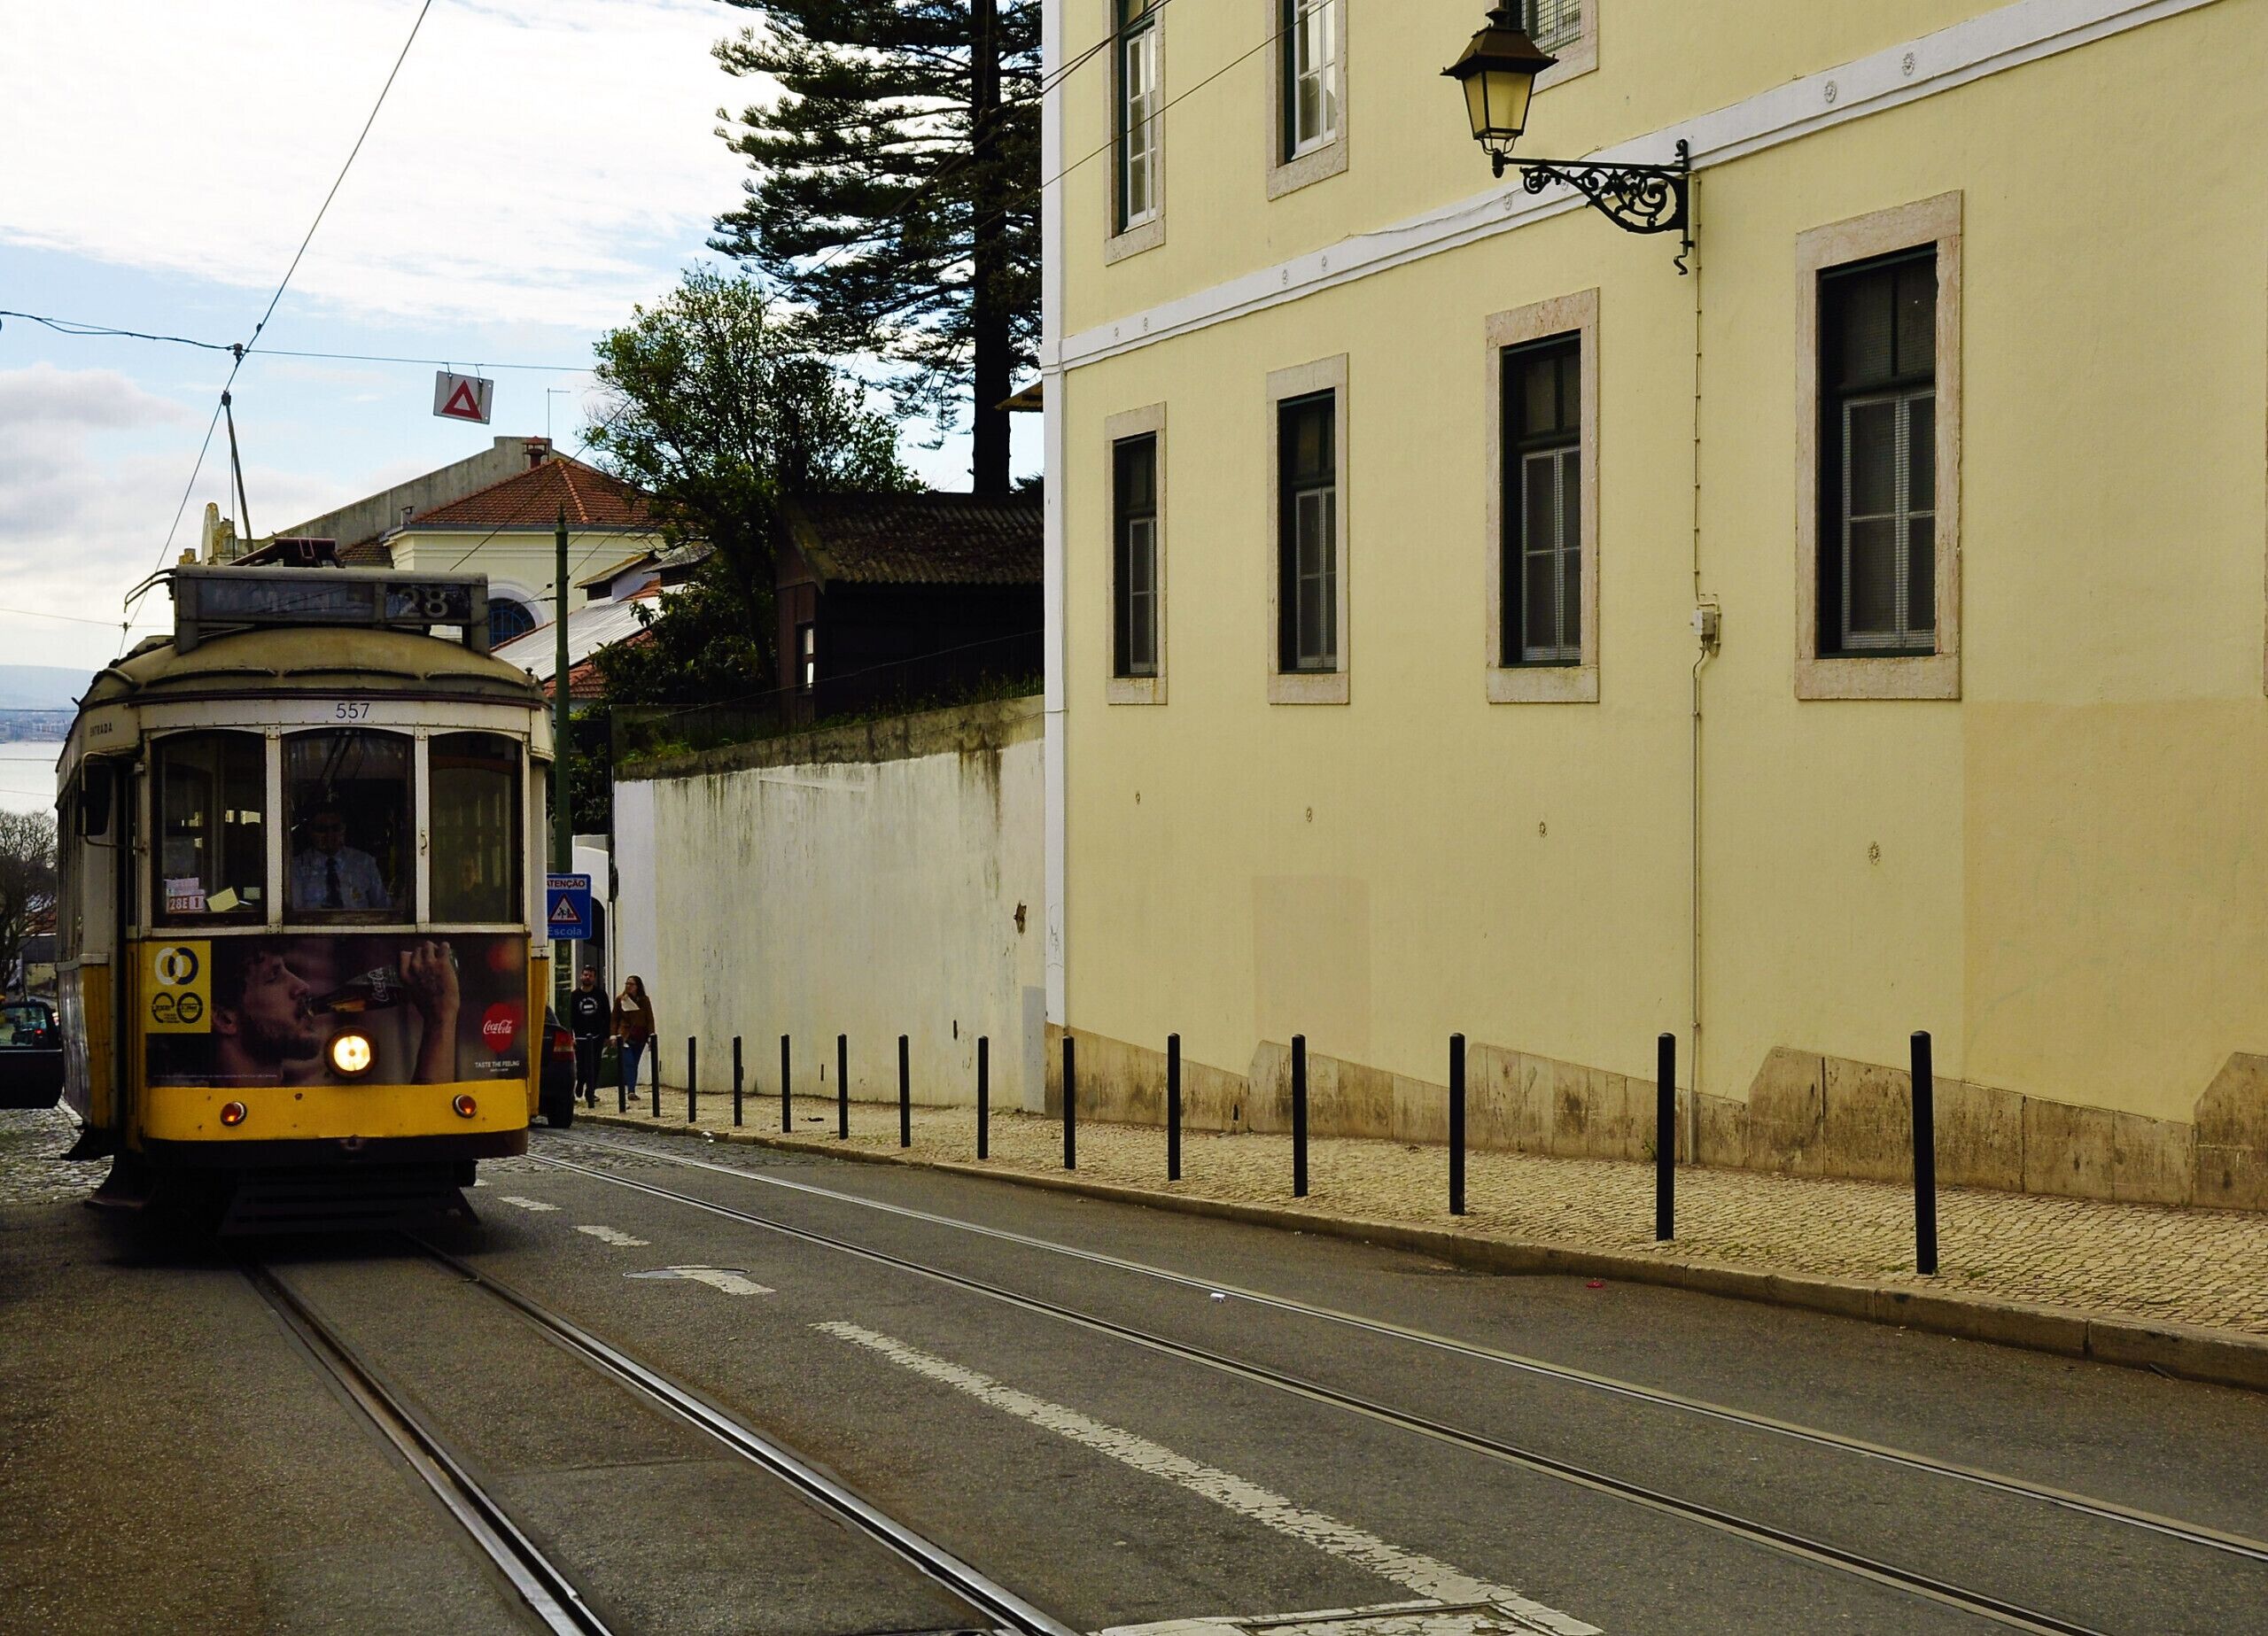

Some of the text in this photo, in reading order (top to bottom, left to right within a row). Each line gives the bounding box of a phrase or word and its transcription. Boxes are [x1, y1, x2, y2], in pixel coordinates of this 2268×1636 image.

[398, 586, 448, 617] 28
[335, 702, 370, 719] 557
[169, 896, 189, 911] 28E
[547, 926, 582, 936] Escola
[483, 1019, 513, 1035] Coca-Cola
